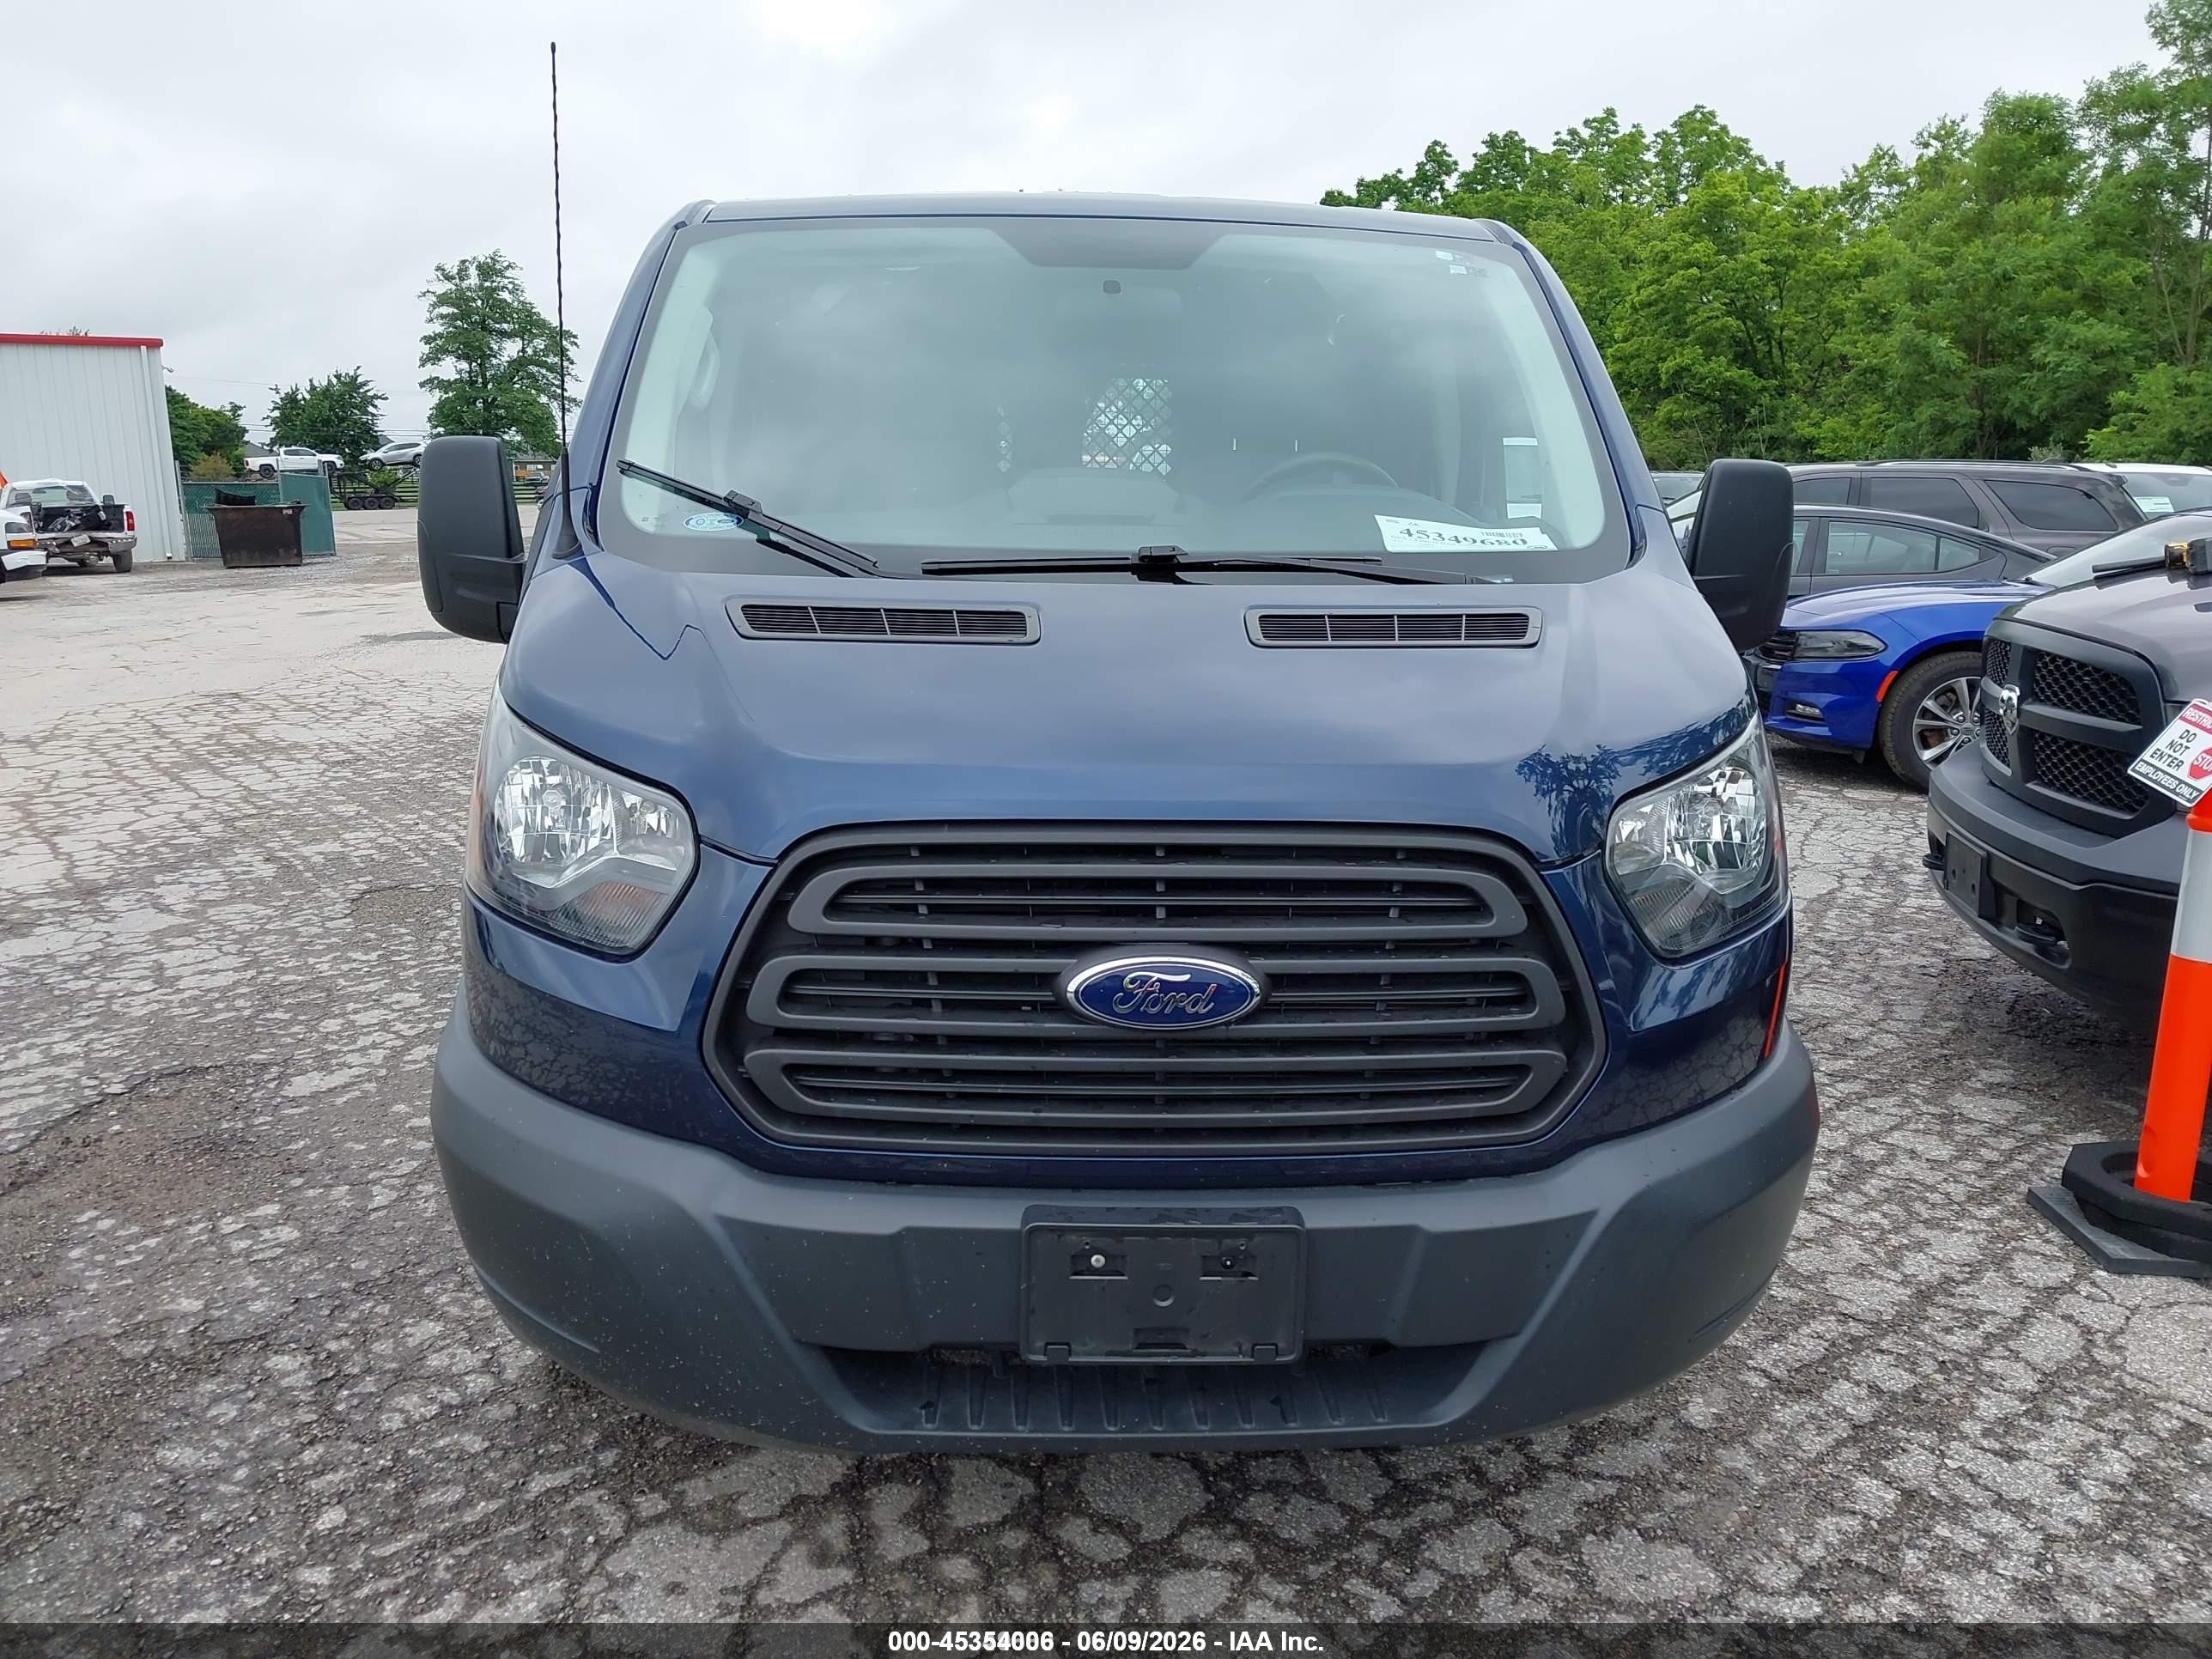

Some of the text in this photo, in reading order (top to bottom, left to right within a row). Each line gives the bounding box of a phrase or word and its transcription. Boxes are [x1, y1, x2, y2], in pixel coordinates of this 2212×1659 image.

[1399, 527, 1528, 547] 45349680
[2179, 729, 2197, 744] DO
[2166, 740, 2191, 756] NOT
[2149, 748, 2185, 771] ENTER
[2135, 761, 2200, 799] EMPLOYEES ONLY
[1112, 971, 1218, 1014] Ford
